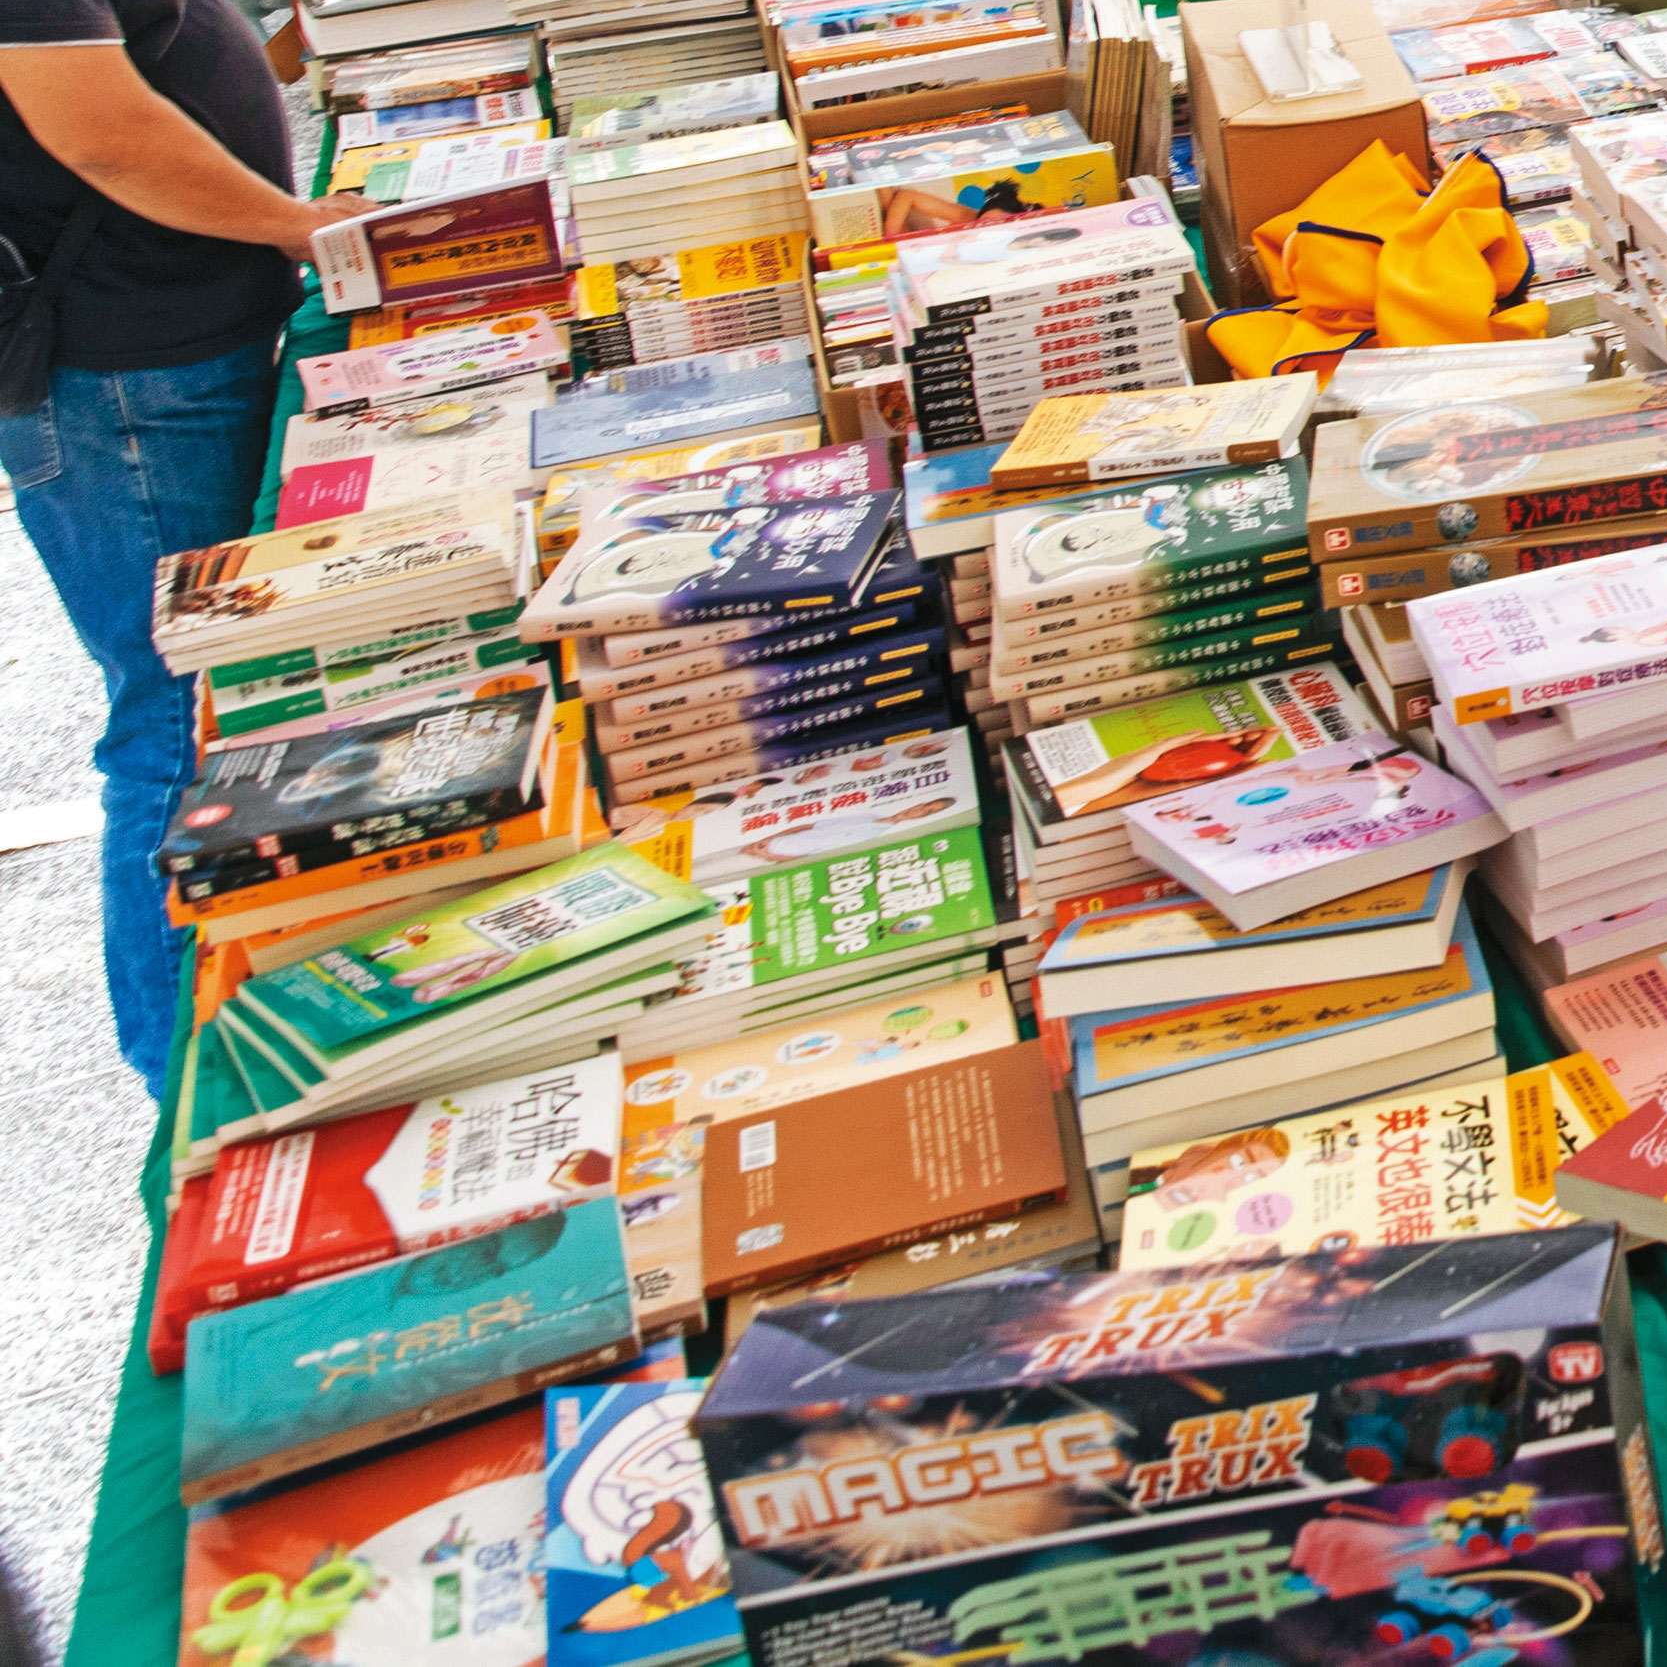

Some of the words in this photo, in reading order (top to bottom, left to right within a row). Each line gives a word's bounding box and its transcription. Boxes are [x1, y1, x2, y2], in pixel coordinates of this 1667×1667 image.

[1107, 1264, 1284, 1324] TRIX
[1023, 1311, 1264, 1375] TRUX
[1555, 1356, 1597, 1380] TV
[1167, 1394, 1319, 1457] TRIX
[722, 1414, 1130, 1547] MAGIC
[1126, 1441, 1313, 1504] TRUX
